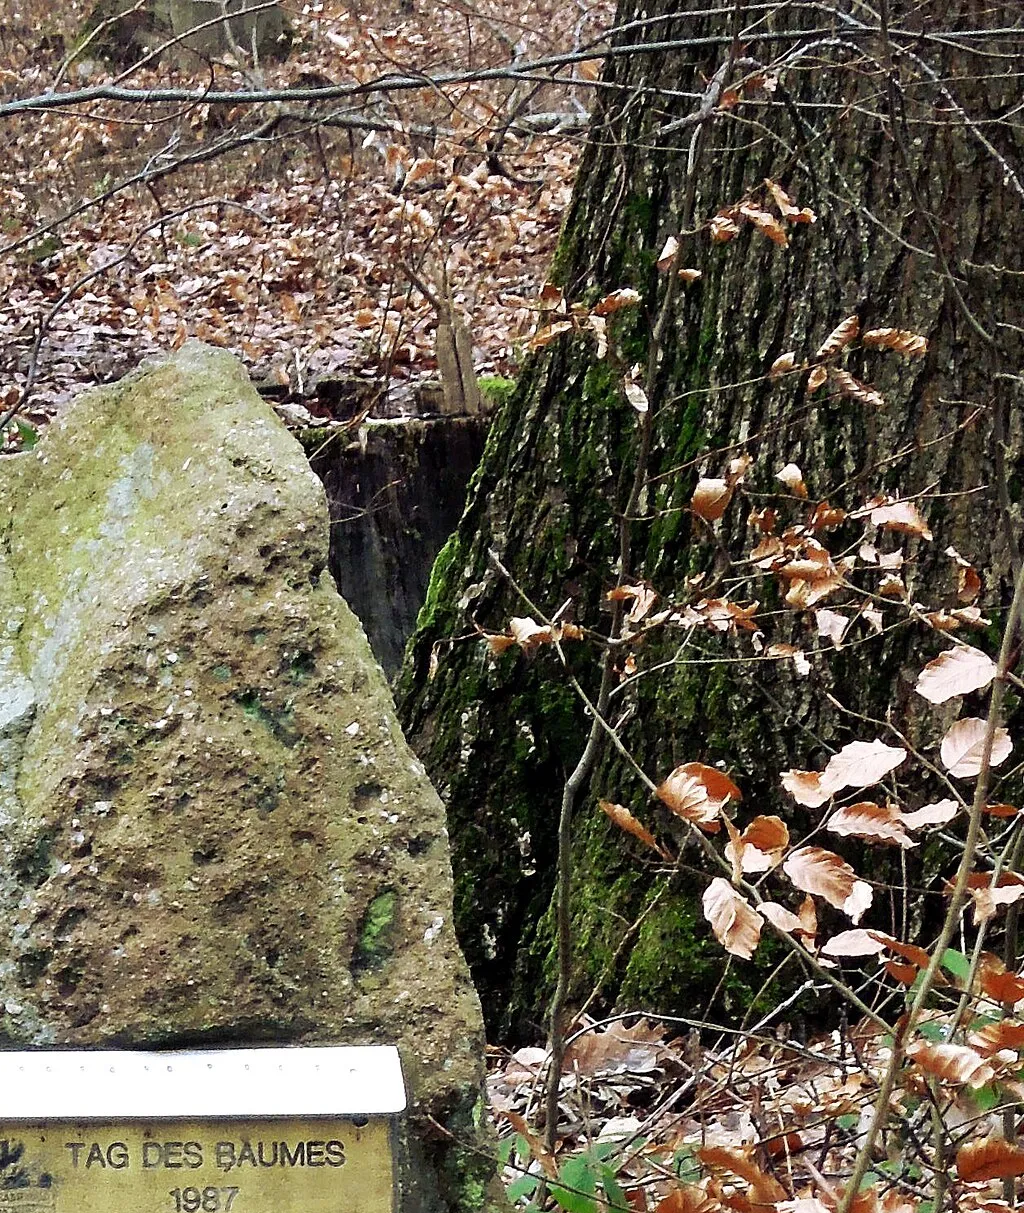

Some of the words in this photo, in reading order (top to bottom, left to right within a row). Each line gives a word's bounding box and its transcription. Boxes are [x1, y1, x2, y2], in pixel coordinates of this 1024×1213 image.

[64, 1141, 130, 1169] TAG
[142, 1141, 203, 1169] DES
[215, 1140, 346, 1169] BAUMES
[169, 1186, 239, 1213] 1987
